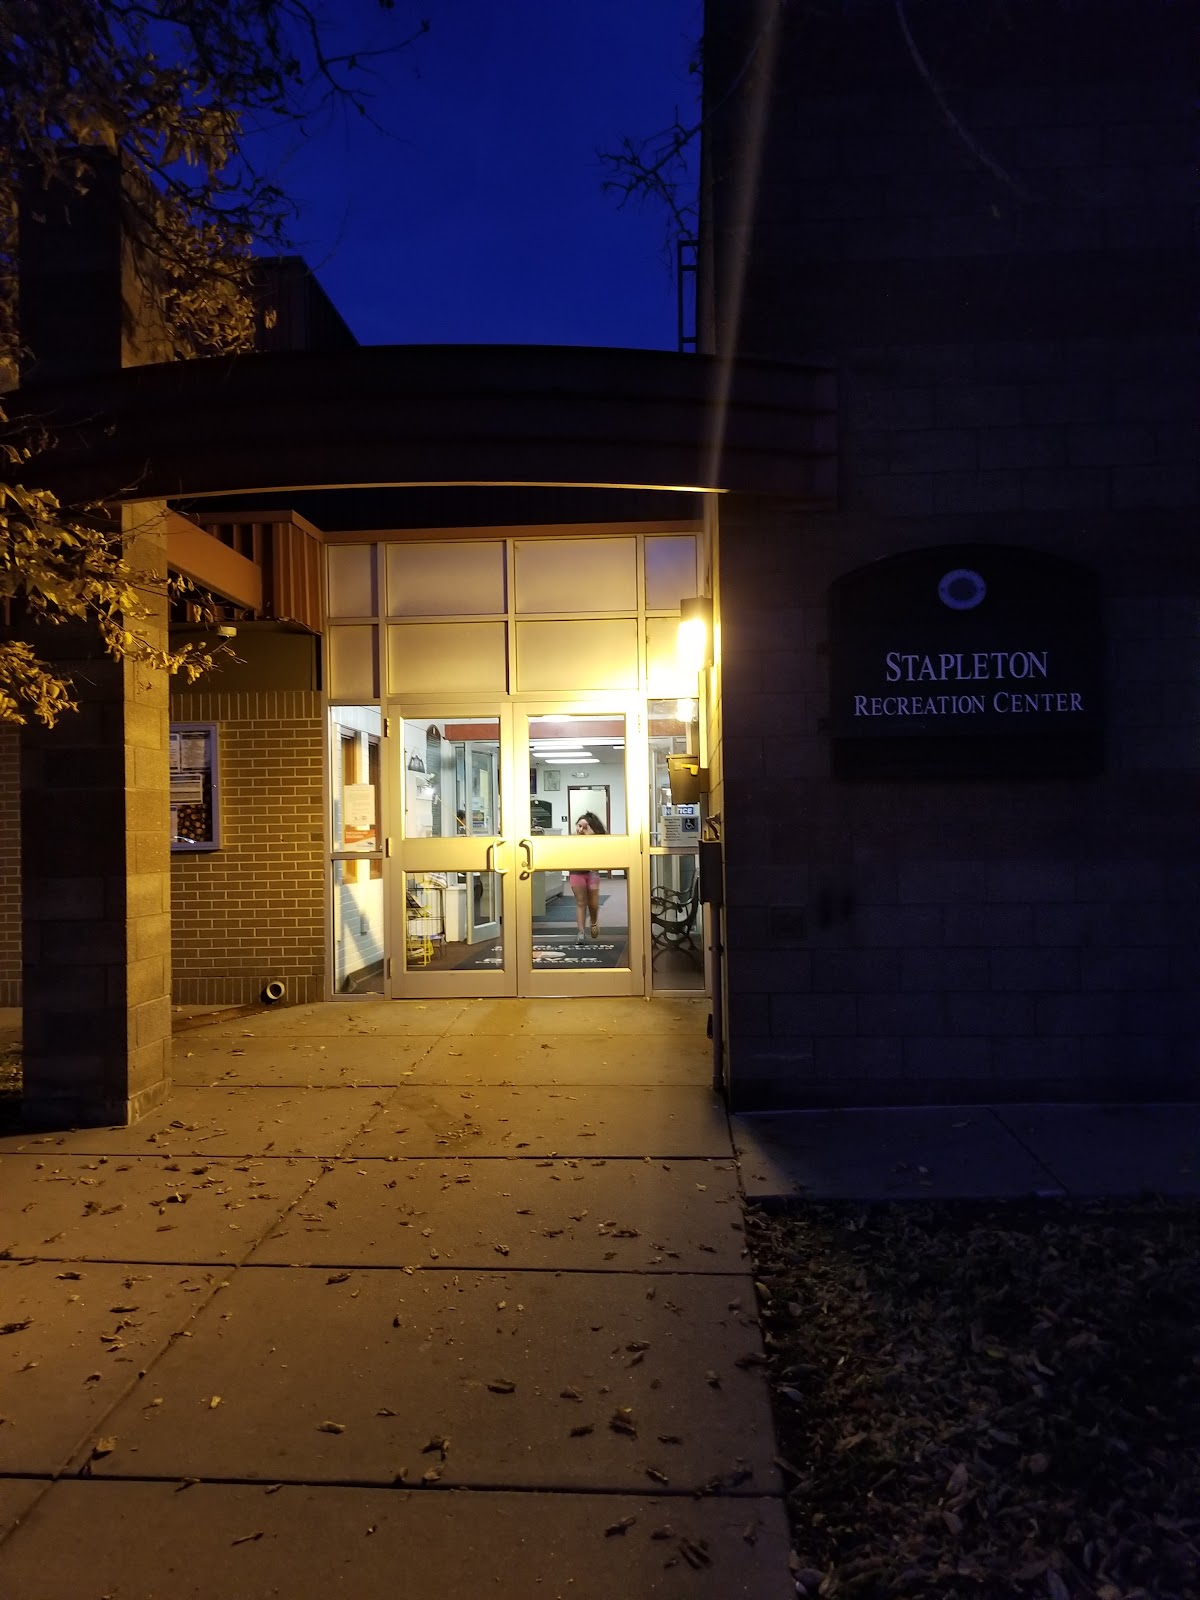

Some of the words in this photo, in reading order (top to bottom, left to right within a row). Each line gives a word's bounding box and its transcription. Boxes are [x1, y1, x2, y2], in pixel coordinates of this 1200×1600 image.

[885, 651, 1049, 682] STAPLETON
[853, 695, 986, 717] RECREATION
[993, 691, 1085, 713] CENTER
